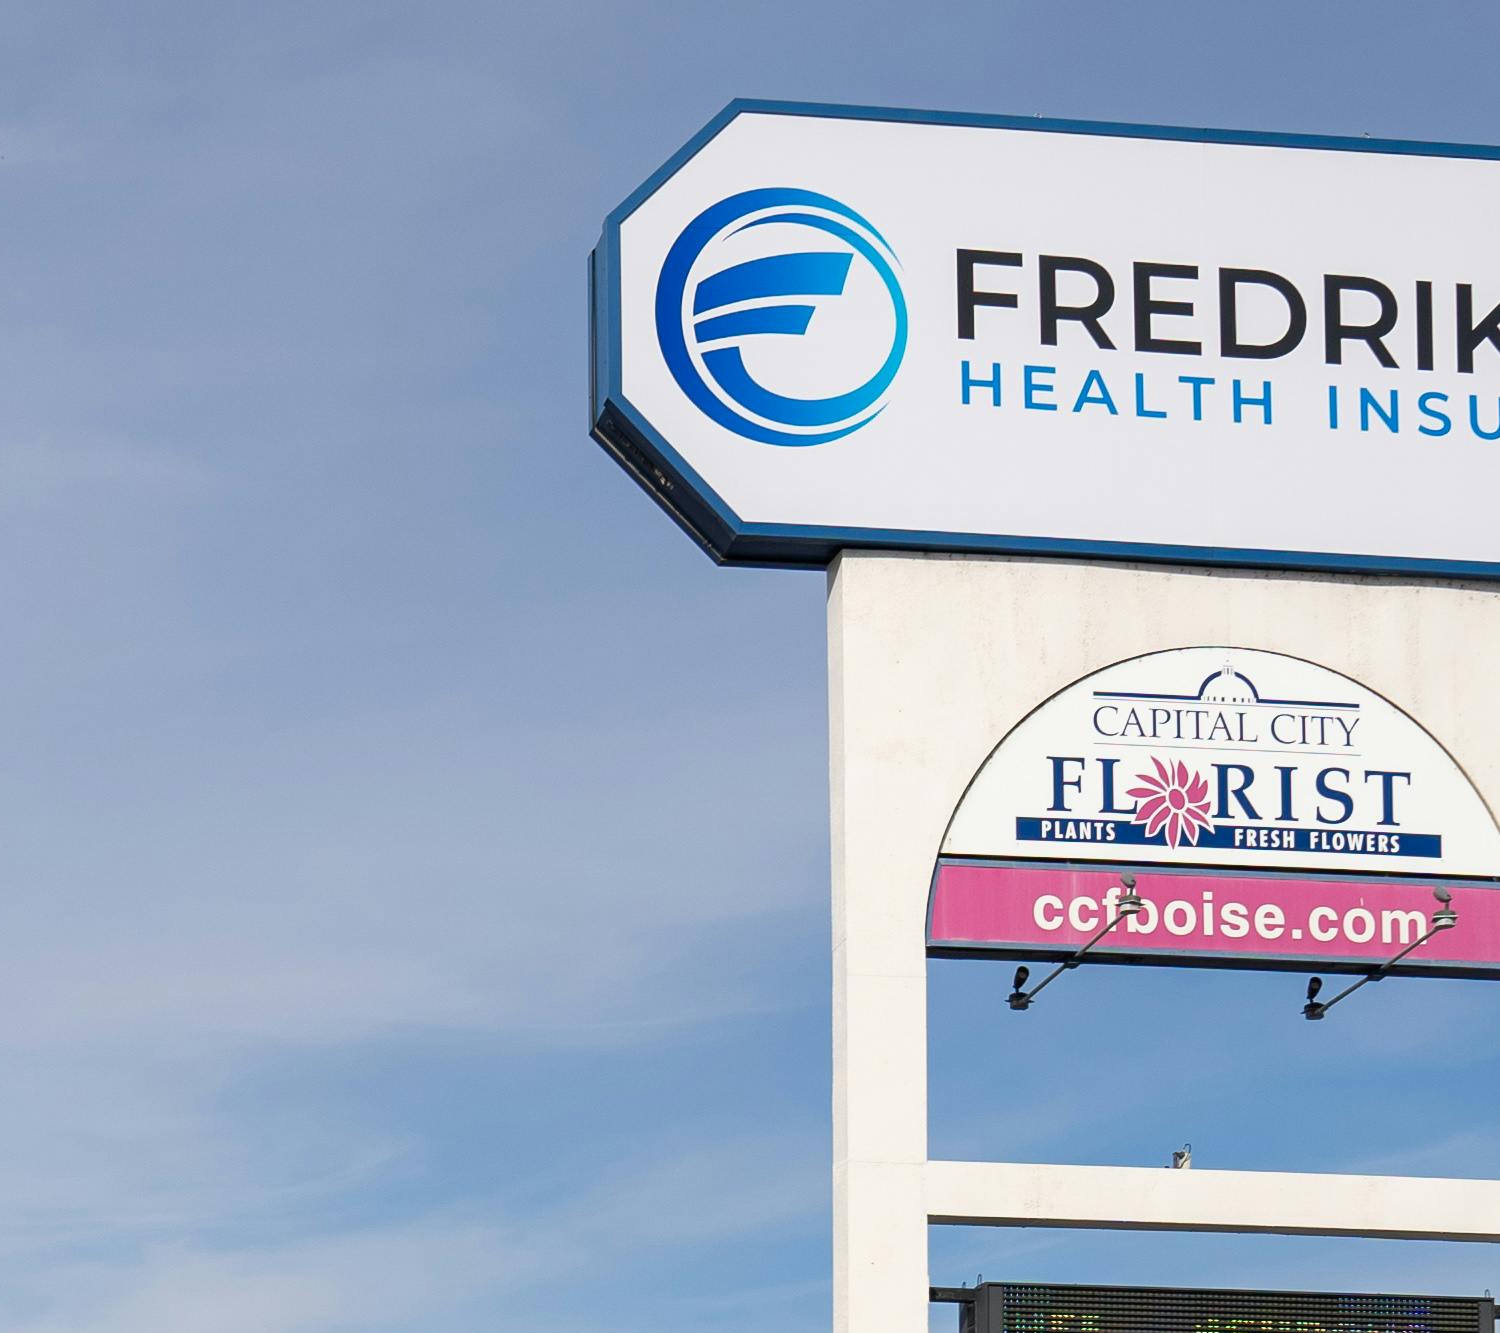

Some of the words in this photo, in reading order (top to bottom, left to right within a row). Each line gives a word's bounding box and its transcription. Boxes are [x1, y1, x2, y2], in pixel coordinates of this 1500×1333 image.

[960, 359, 1274, 426] HEALTH
[1092, 705, 1258, 743] CAPITAL
[1270, 713, 1360, 748] CITY
[1041, 820, 1116, 841] PLANTS
[1234, 828, 1296, 849] FRESH
[1309, 831, 1400, 853] FLOWERS
[1033, 886, 1429, 946] ccfboise.com
